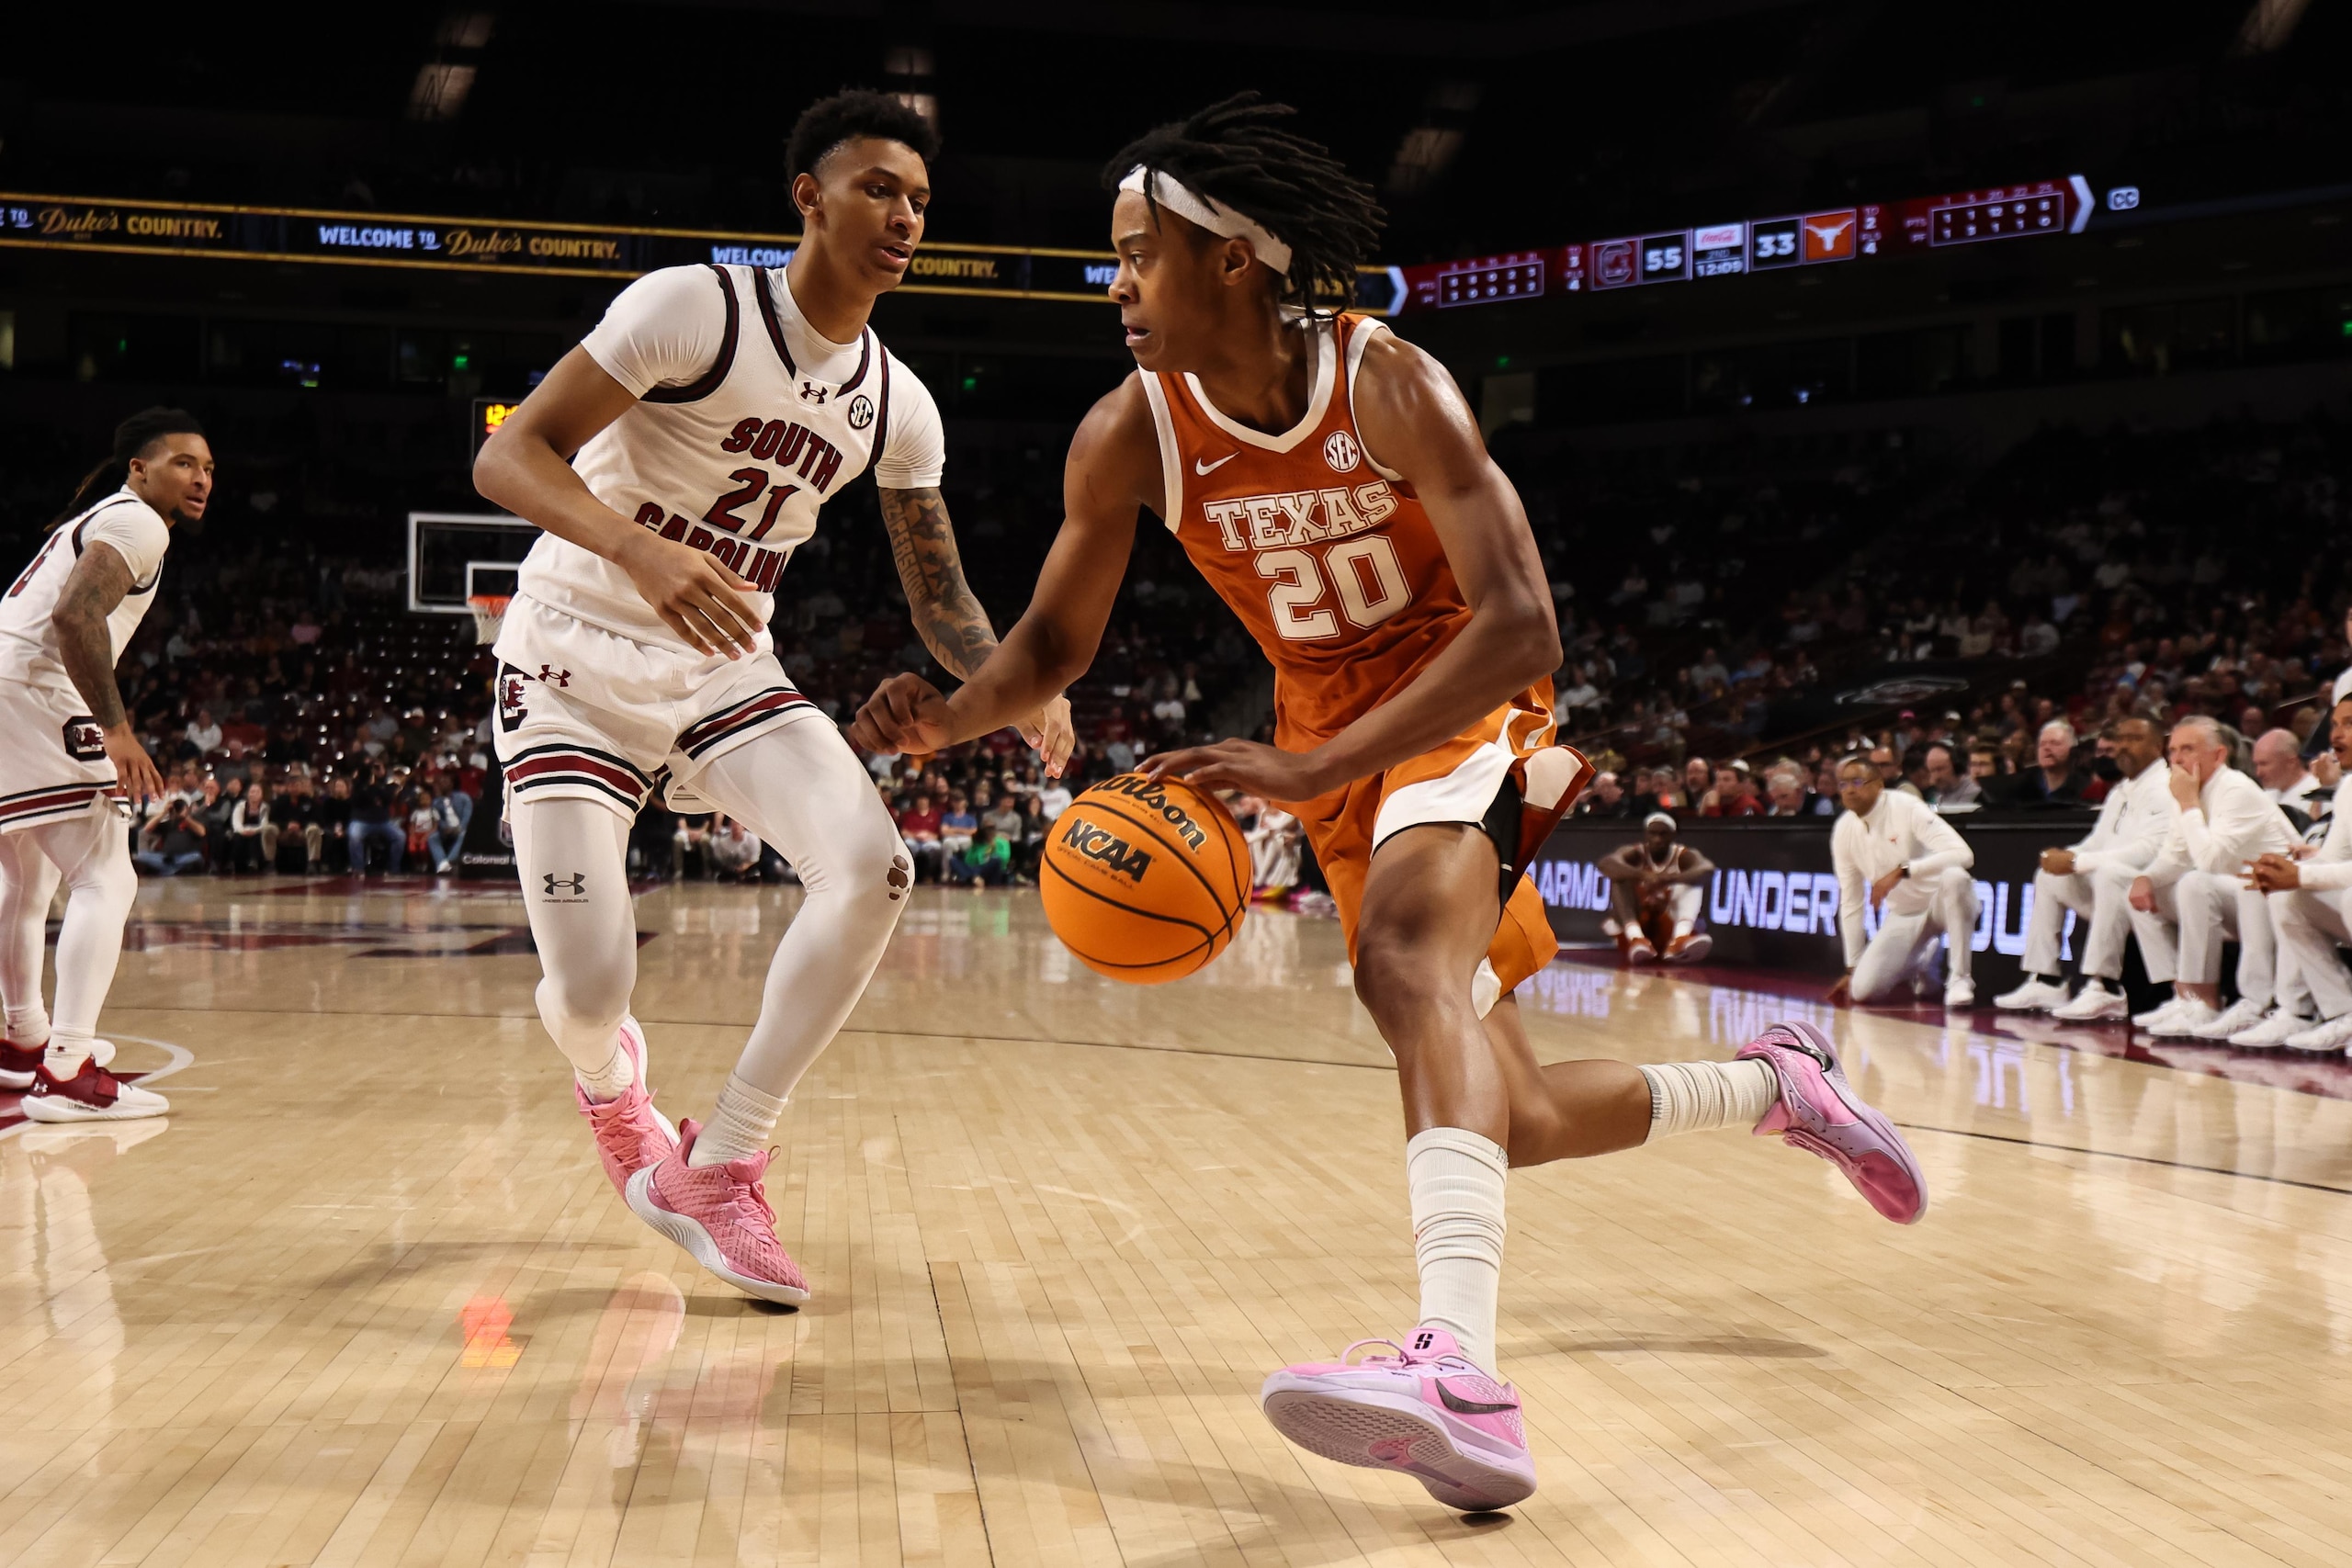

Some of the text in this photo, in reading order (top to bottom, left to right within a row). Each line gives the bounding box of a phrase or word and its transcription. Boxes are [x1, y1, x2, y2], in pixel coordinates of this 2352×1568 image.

[10, 208, 34, 228] TO
[38, 208, 119, 235] Duke's
[127, 216, 223, 239] COUNTRY.
[319, 226, 621, 260] WELCOME TO Duke's COUNTRY.
[712, 246, 796, 267] WELCOM
[1645, 247, 1682, 271] 55
[1756, 232, 1795, 257] 33
[912, 258, 999, 278] COUNTRY.
[720, 416, 842, 494] SOUTH
[1327, 434, 1359, 470] SEC
[702, 467, 800, 541] 21
[1204, 479, 1398, 550] TEXAS
[1253, 534, 1412, 640] 20
[1091, 775, 1208, 854] Wilson
[462, 853, 510, 864] Colonial
[1061, 818, 1152, 883] NCAA
[1710, 869, 1838, 936] UNDER
